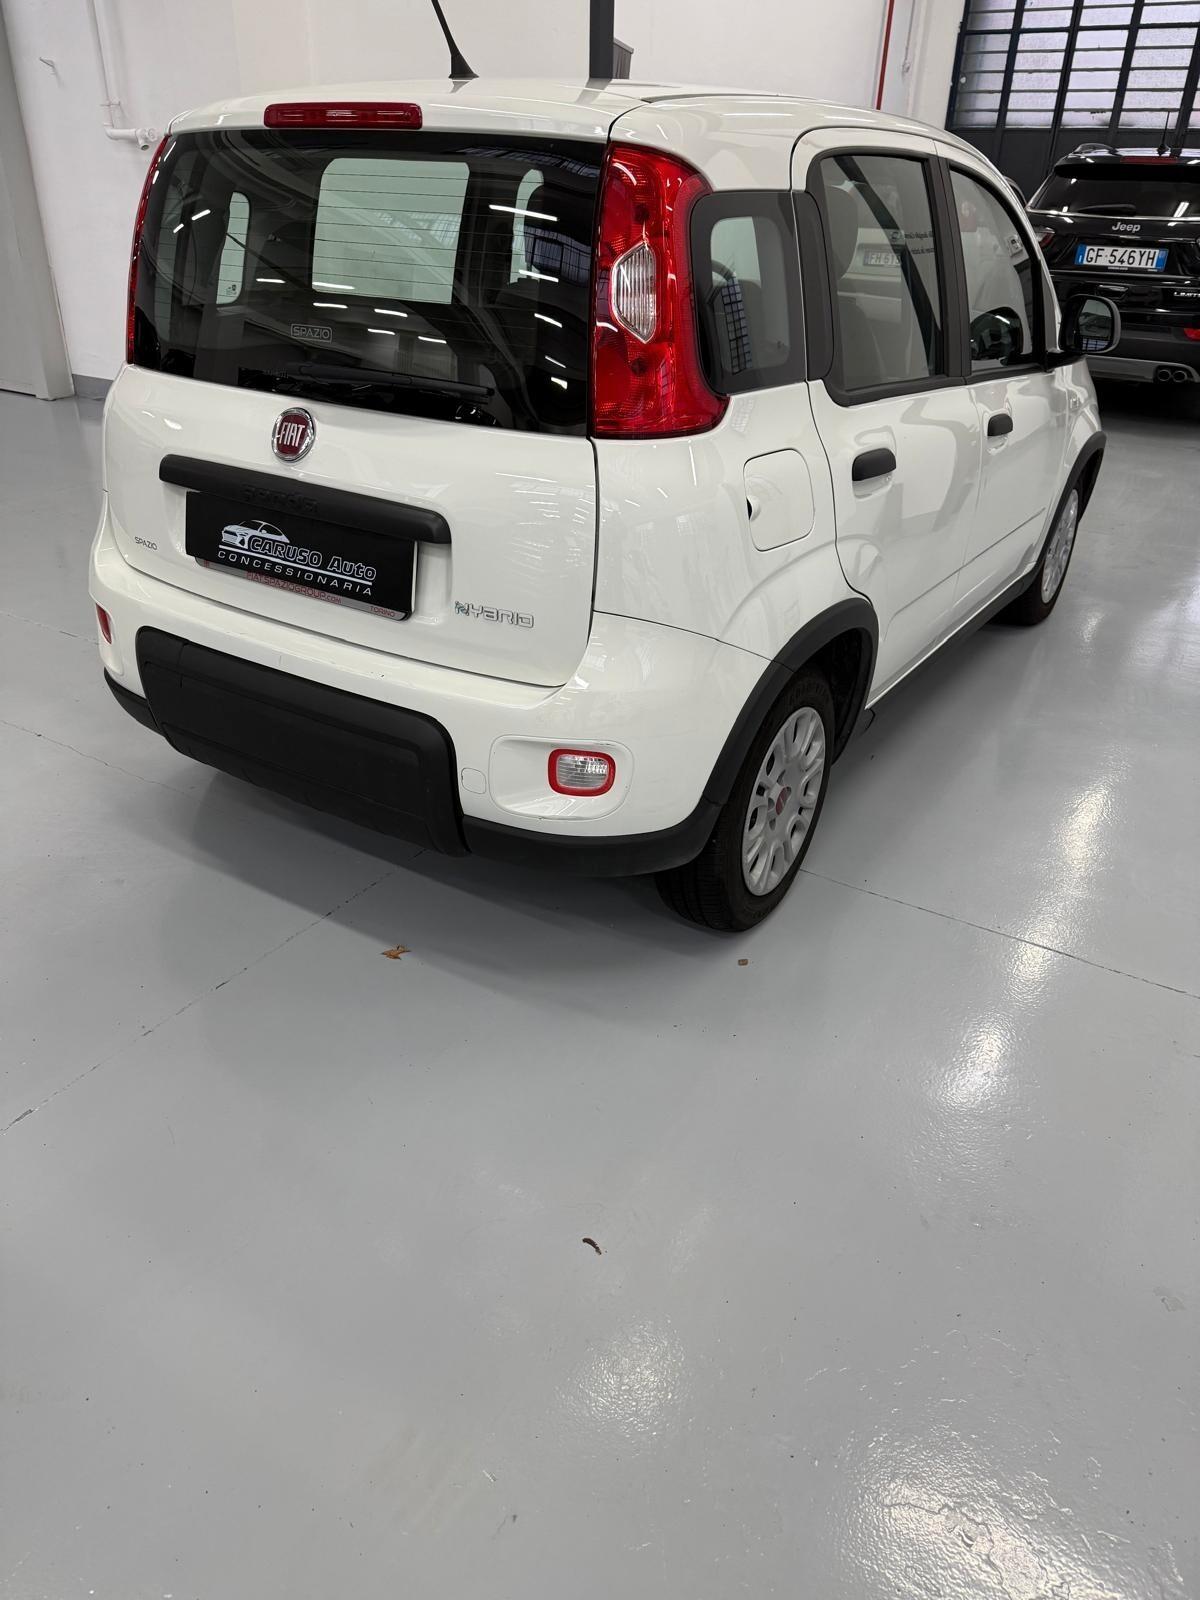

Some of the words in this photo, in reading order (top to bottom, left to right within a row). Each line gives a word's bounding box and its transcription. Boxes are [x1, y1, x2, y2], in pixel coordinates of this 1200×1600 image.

[1111, 221, 1141, 233] Jeep
[1086, 247, 1105, 264] GF
[1108, 248, 1157, 267] 546YH
[293, 326, 330, 339] SPAZIO
[279, 422, 305, 447] FIAT
[134, 536, 158, 551] SPAZIO
[251, 535, 323, 567] CARUSO
[327, 556, 377, 581] Auto
[218, 550, 372, 596] CONCESSIONARIA
[369, 605, 396, 618] TORINO
[454, 601, 534, 629] HYBRID
